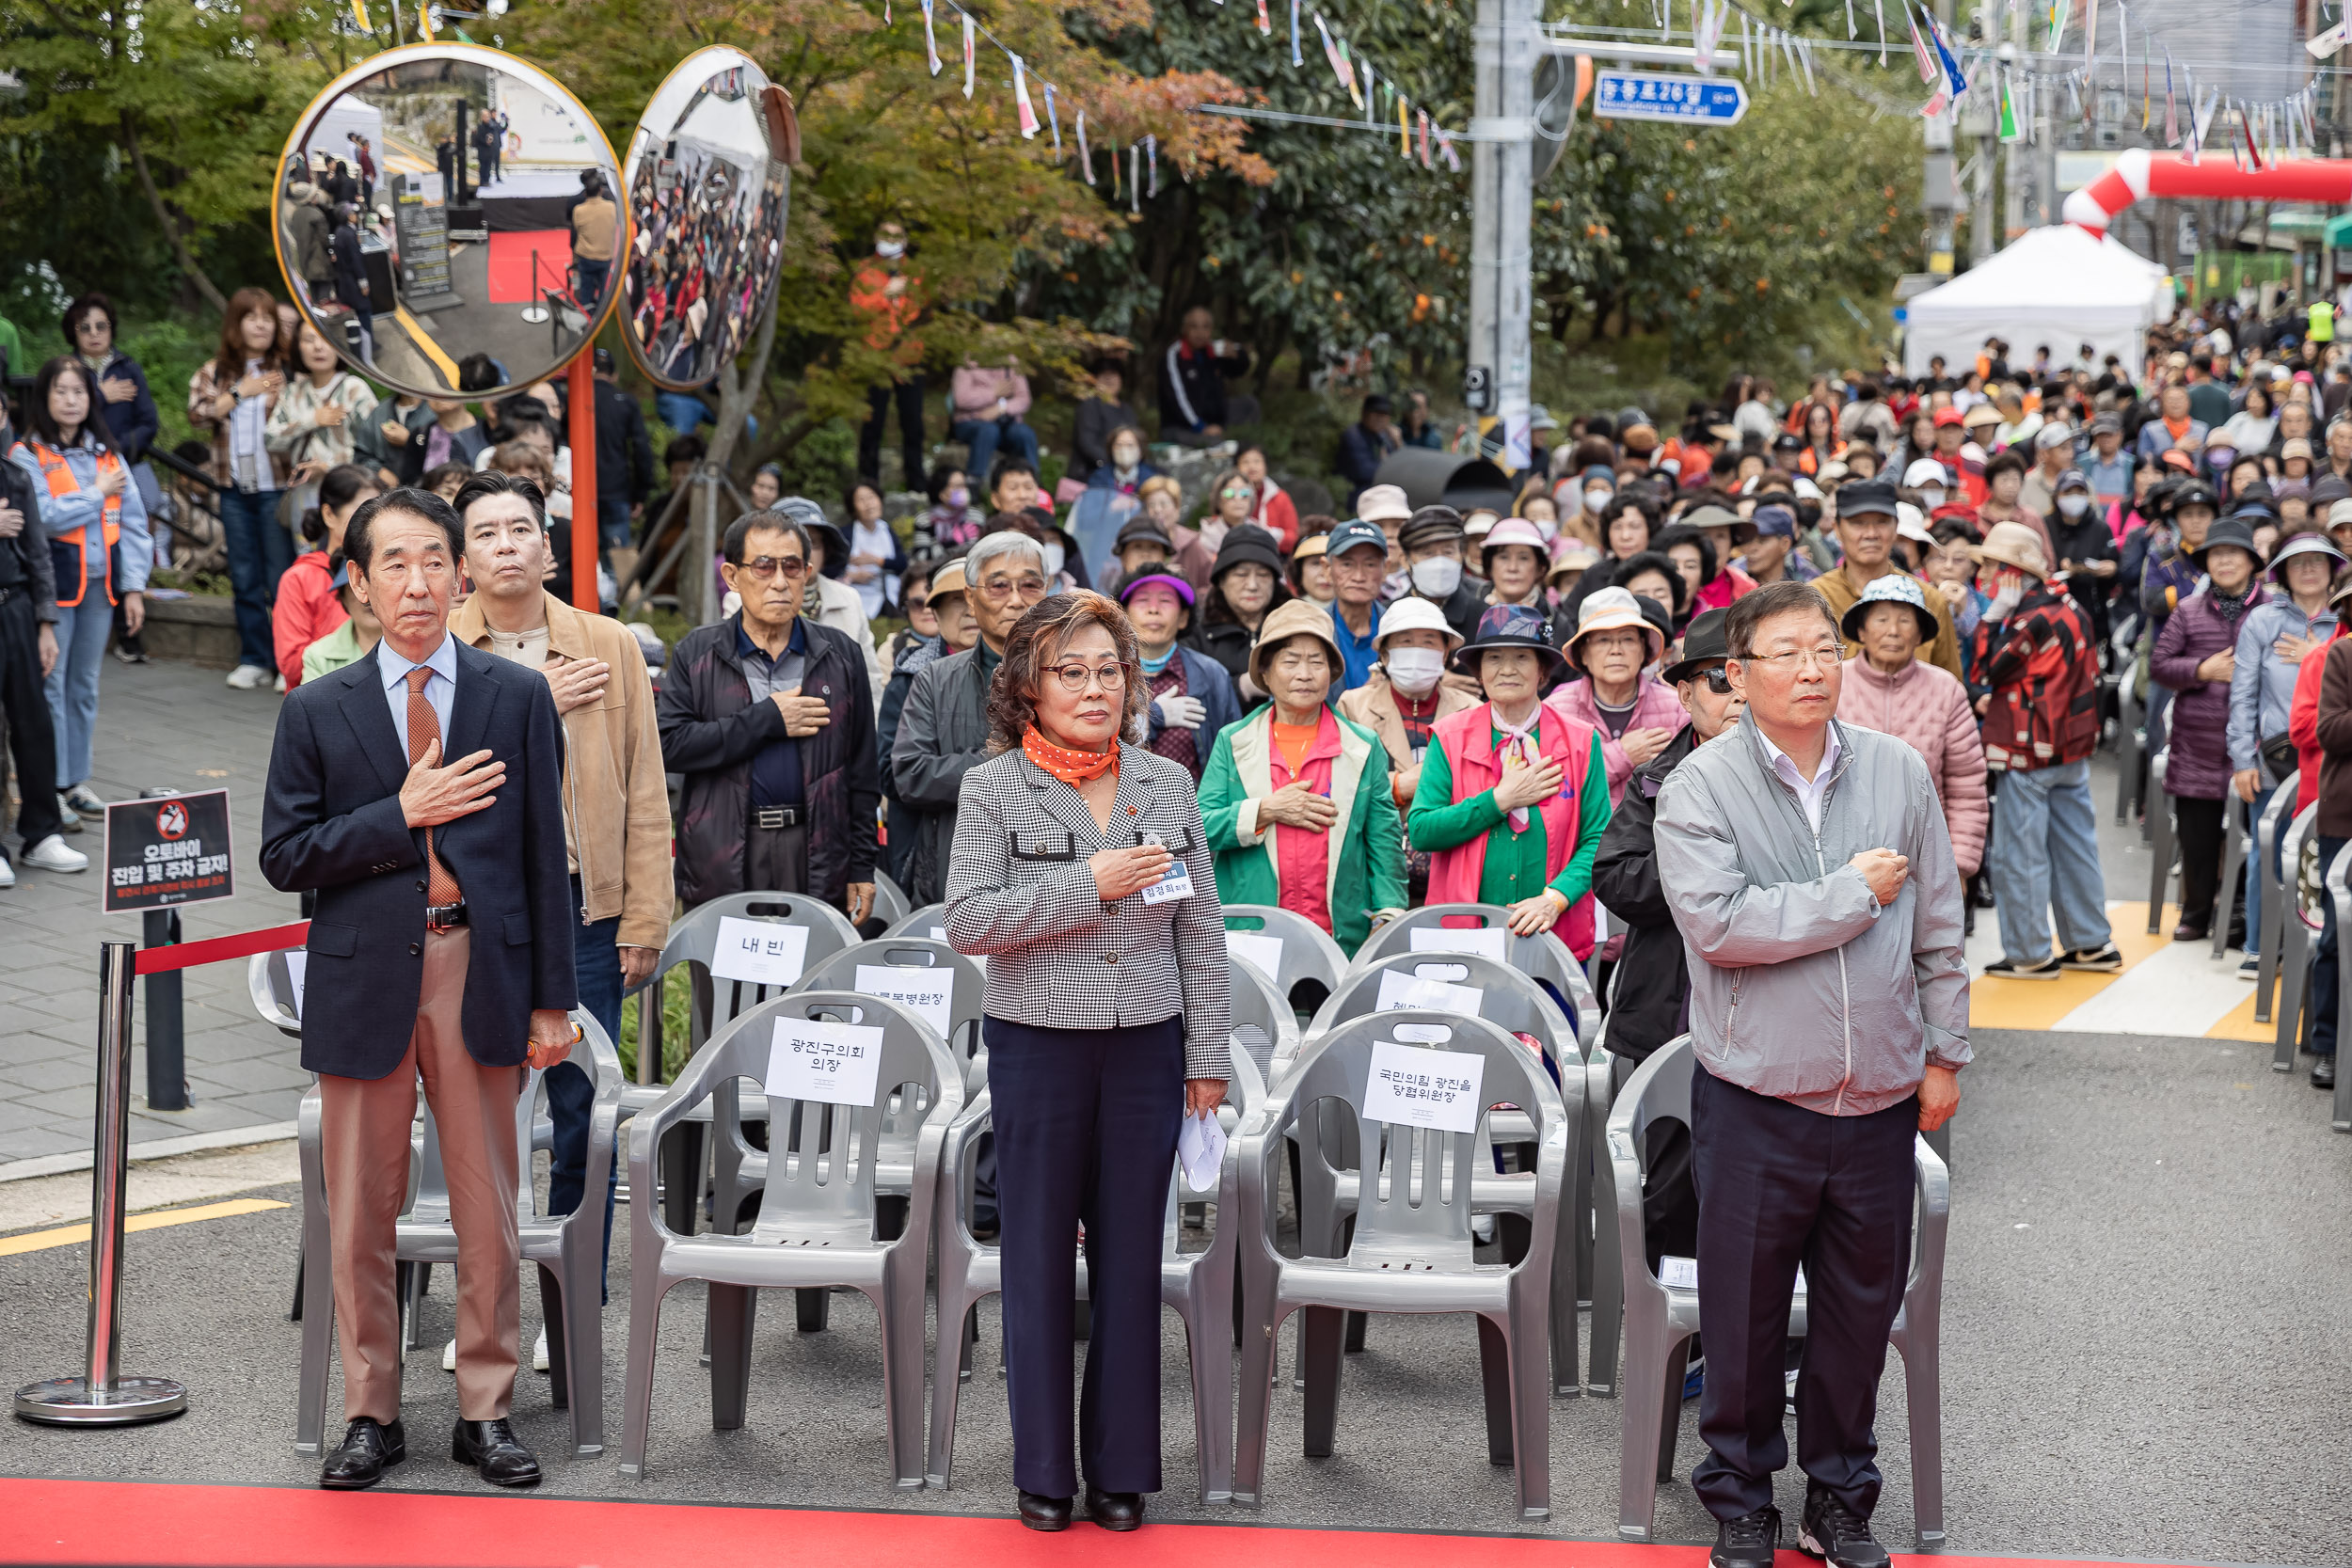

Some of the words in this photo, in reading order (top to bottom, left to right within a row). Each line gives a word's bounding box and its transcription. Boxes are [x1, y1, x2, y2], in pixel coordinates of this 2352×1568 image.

[144, 838, 200, 863] 오토바이
[112, 865, 143, 886] 진입
[147, 863, 163, 882] 및
[166, 860, 195, 879] 주차
[197, 854, 229, 876] 금지!
[1146, 884, 1174, 897] 김경희
[790, 1038, 865, 1059] 광진구의회
[810, 1058, 841, 1072] 의장
[1379, 1069, 1430, 1086] 국민의힘
[1436, 1077, 1471, 1092] 광진을
[1393, 1085, 1456, 1103] 당협위원장
